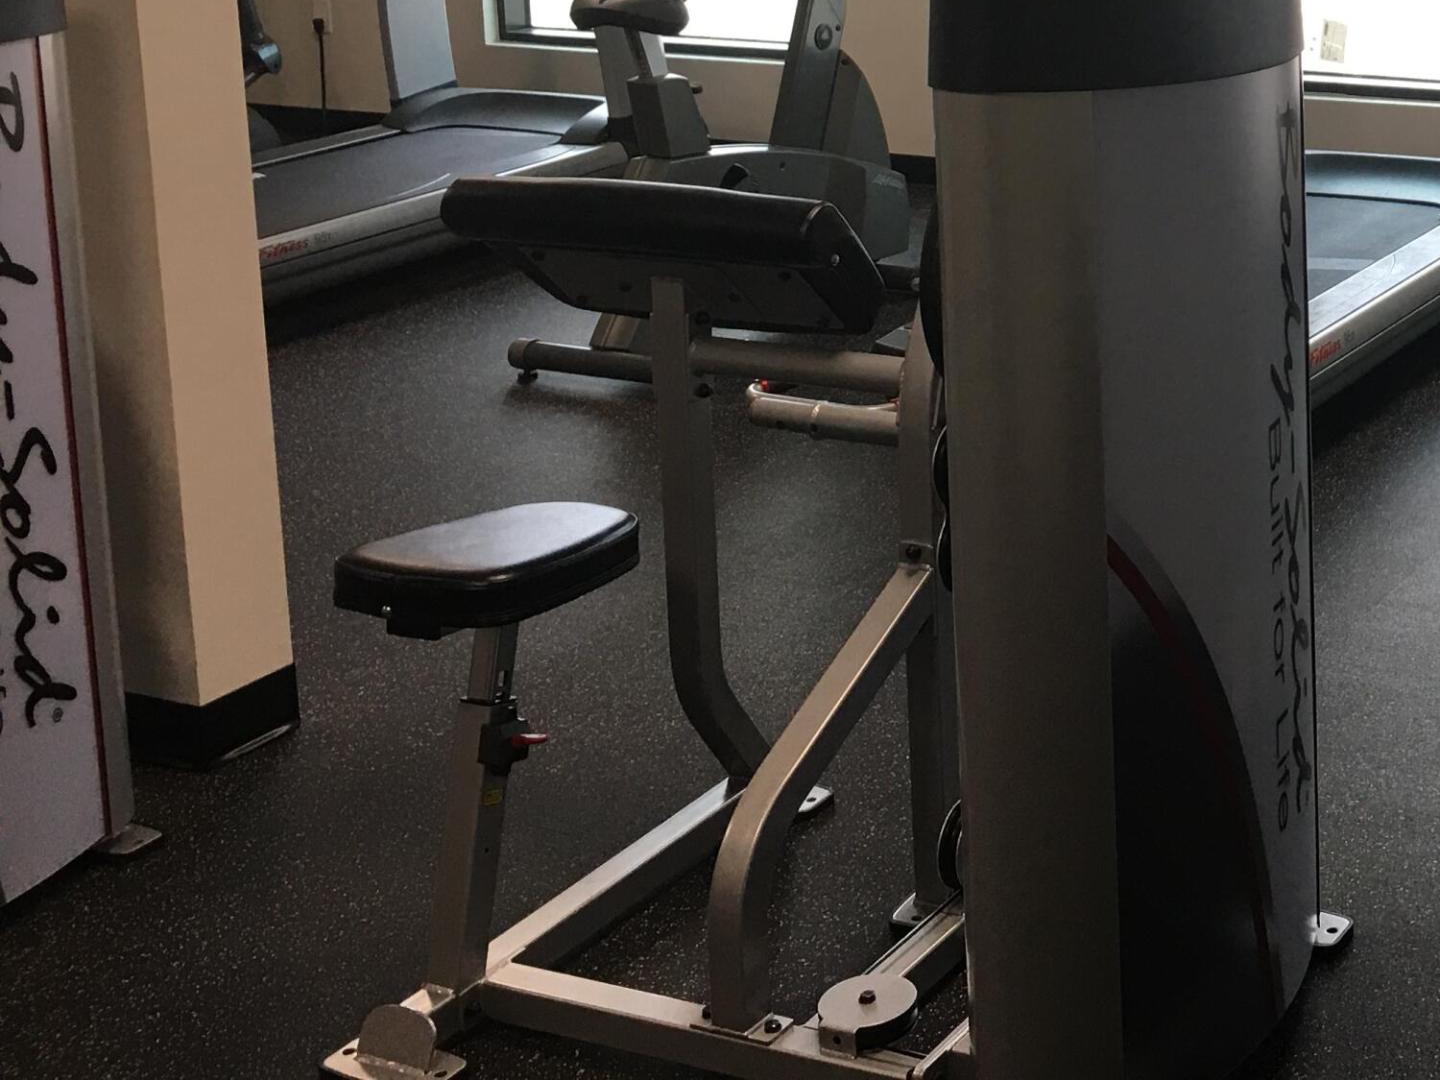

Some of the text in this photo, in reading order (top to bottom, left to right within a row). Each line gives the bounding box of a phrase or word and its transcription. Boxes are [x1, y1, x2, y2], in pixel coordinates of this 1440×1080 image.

[1269, 418, 1290, 832] Built for Life
